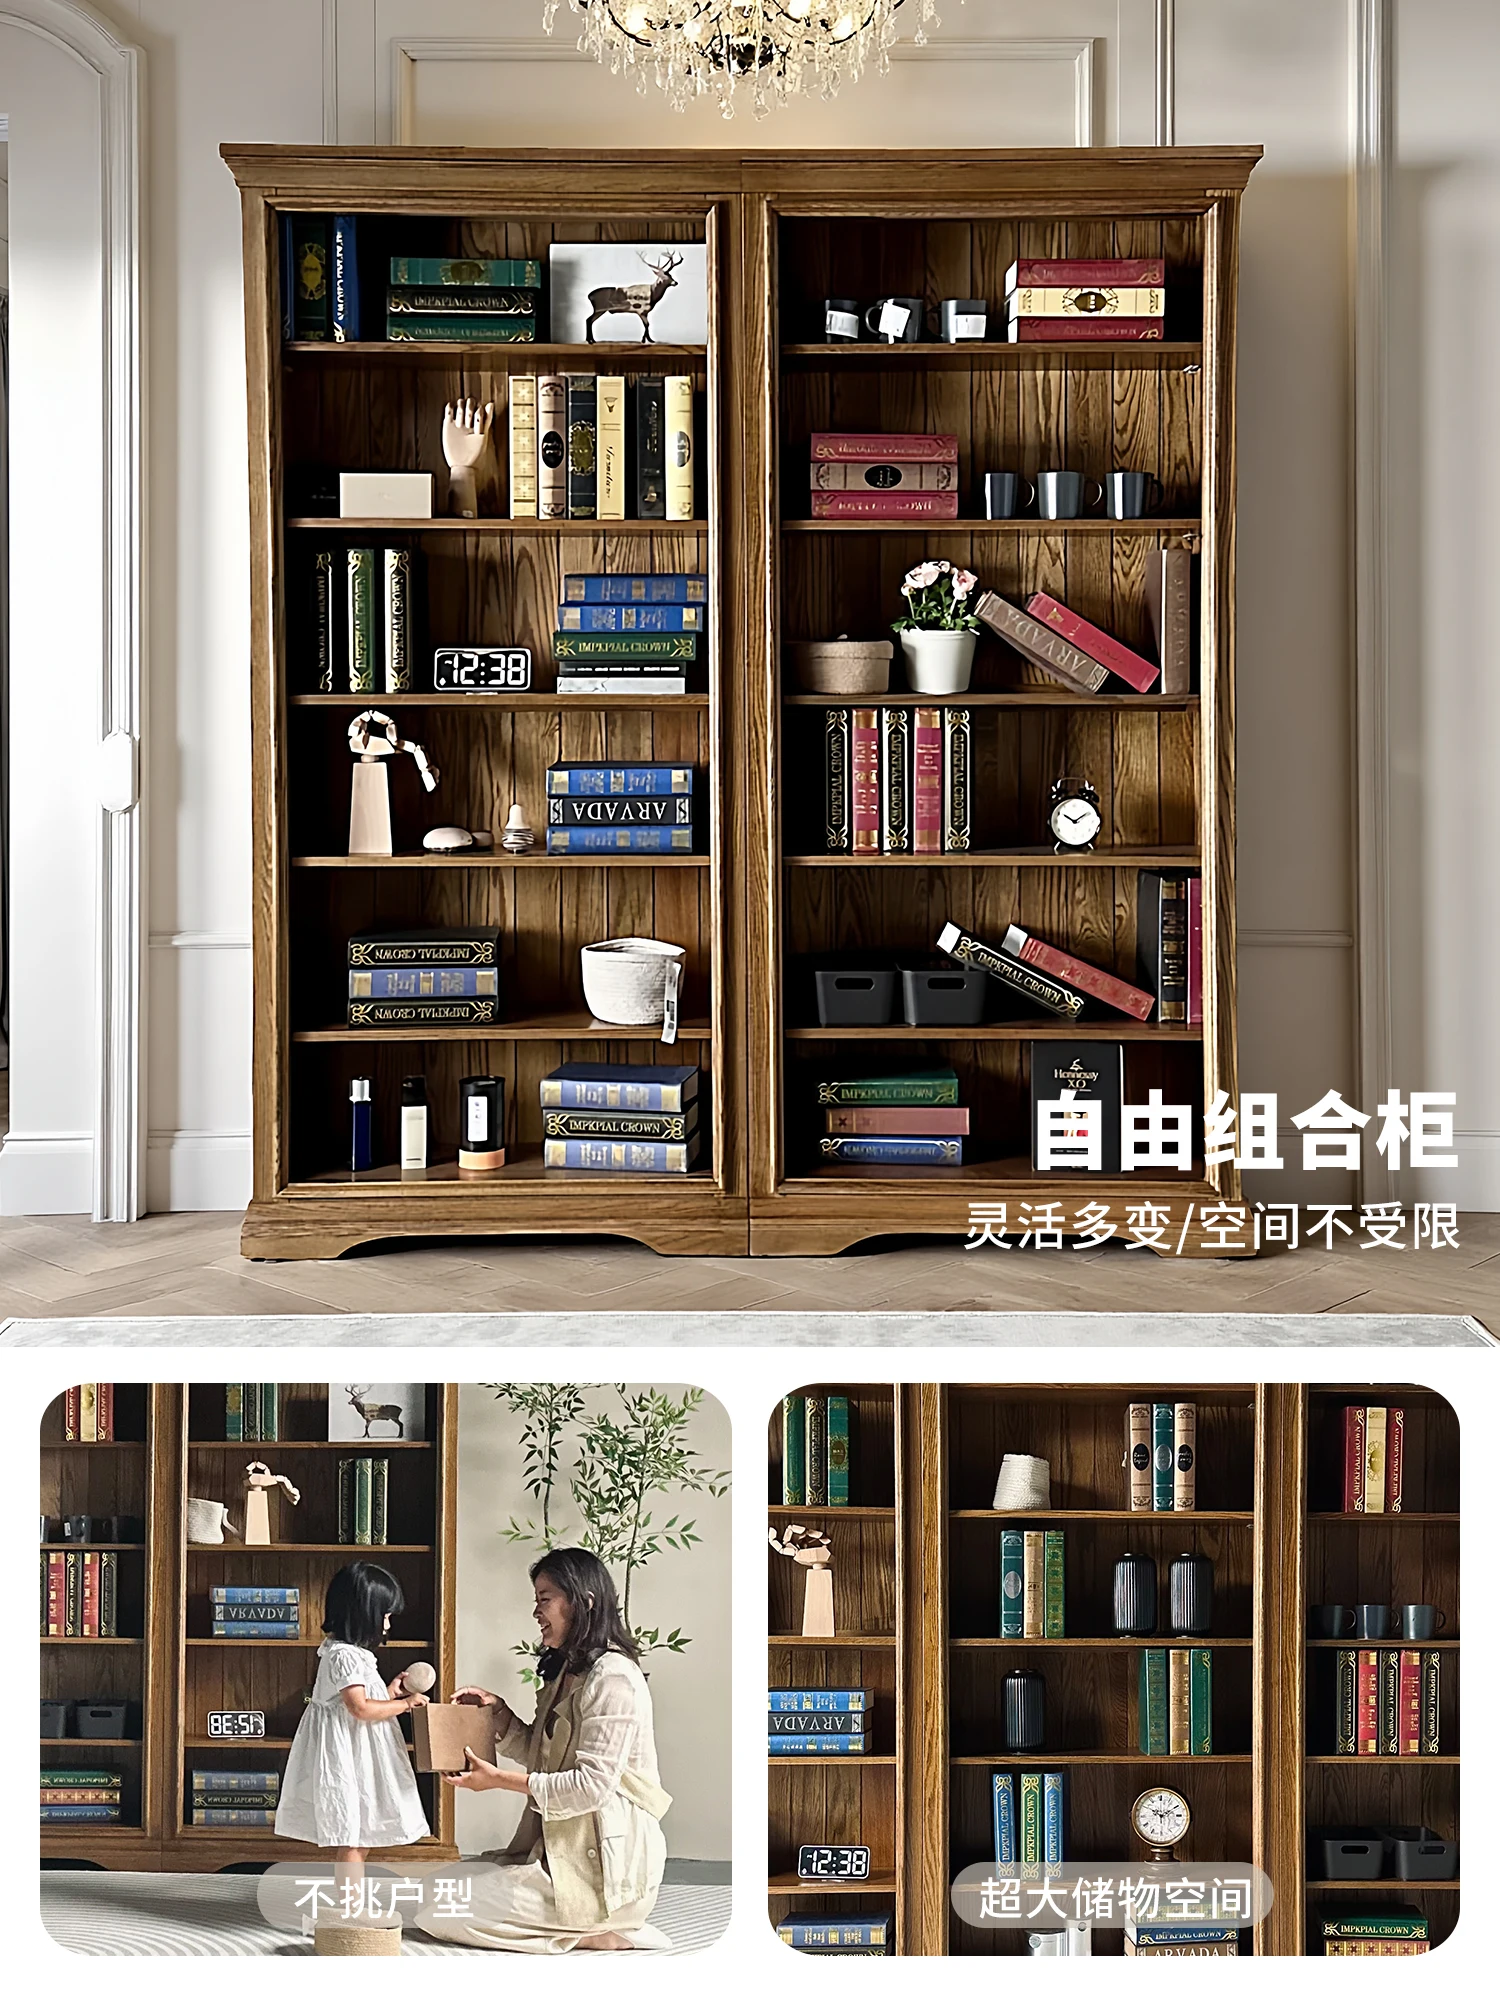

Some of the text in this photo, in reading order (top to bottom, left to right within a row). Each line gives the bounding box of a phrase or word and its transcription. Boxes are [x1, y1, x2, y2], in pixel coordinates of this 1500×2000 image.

[1001, 608, 1088, 673] ARVADA
[831, 733, 842, 773] CROWN
[572, 801, 668, 820] ARVADA
[891, 786, 902, 826] CROWN
[953, 786, 965, 826] CROWN
[375, 948, 417, 960] CROWN
[1023, 976, 1063, 1004] CROWN
[374, 1007, 416, 1020] CROWN
[1067, 1079, 1087, 1089] XO
[620, 1121, 660, 1134] CROWN
[772, 1716, 846, 1731] ARVADA
[1428, 1707, 1436, 1737] CROWN
[1000, 1792, 1008, 1822] CROWN
[1027, 1794, 1035, 1822] CROWN
[1049, 1794, 1057, 1822] CROWN
[811, 1849, 867, 1876] 12:38
[1379, 1926, 1409, 1935] CROWN
